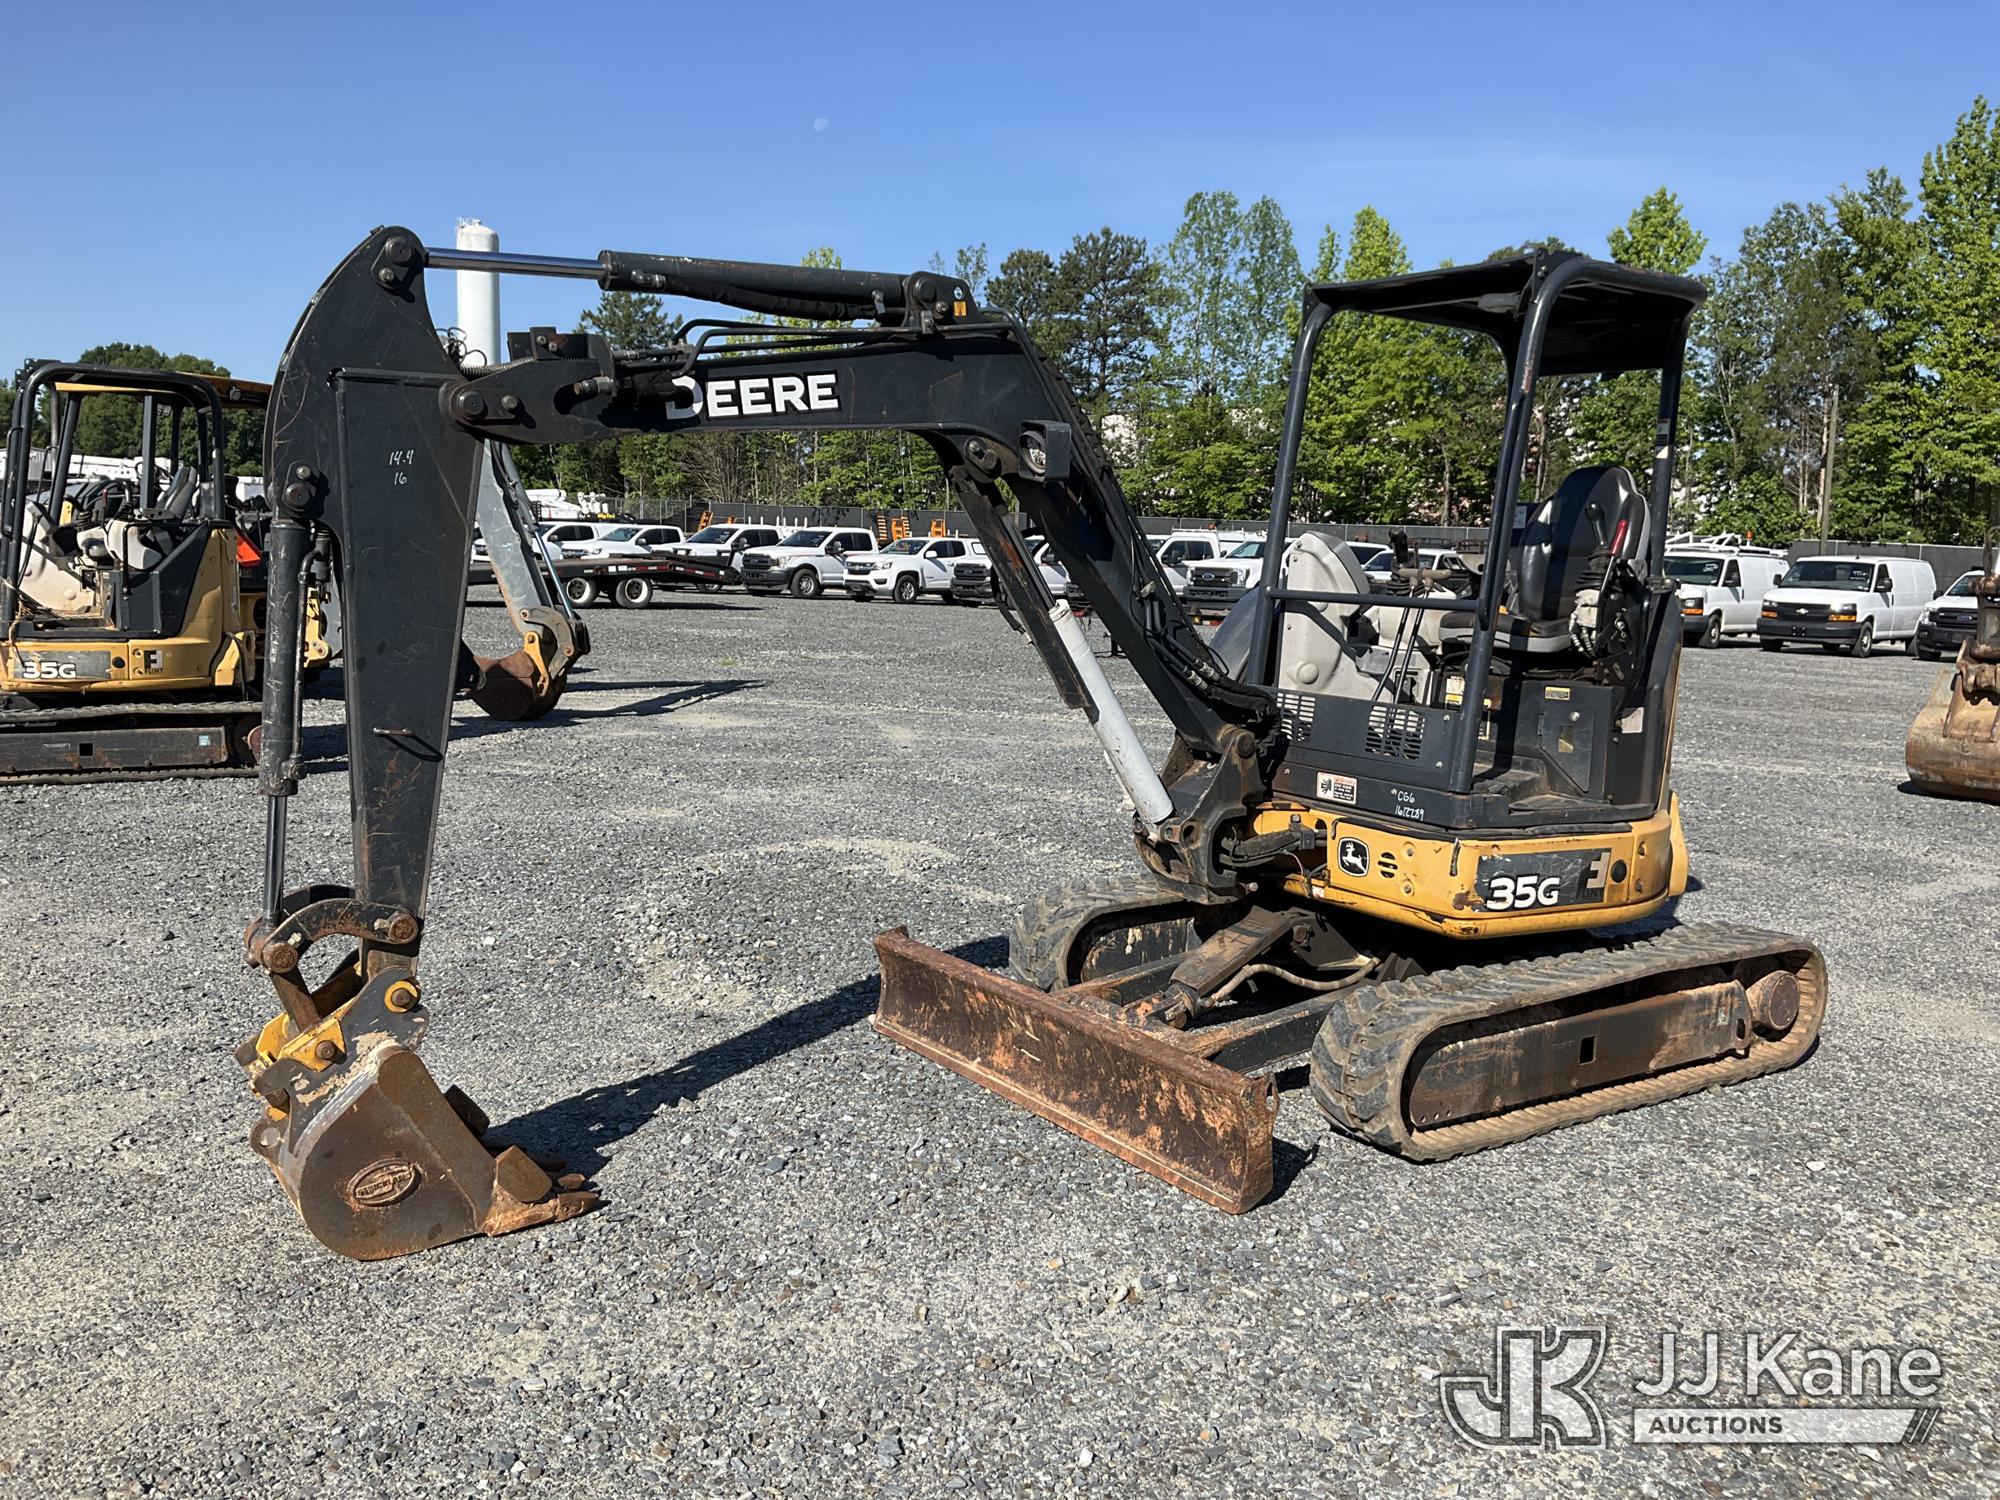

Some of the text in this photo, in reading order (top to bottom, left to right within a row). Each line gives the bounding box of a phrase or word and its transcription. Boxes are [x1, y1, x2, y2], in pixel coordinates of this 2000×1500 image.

[665, 374, 839, 420] DEERE
[394, 472, 407, 485] 16
[23, 661, 76, 679] 35G
[1486, 875, 1560, 910] 35G
